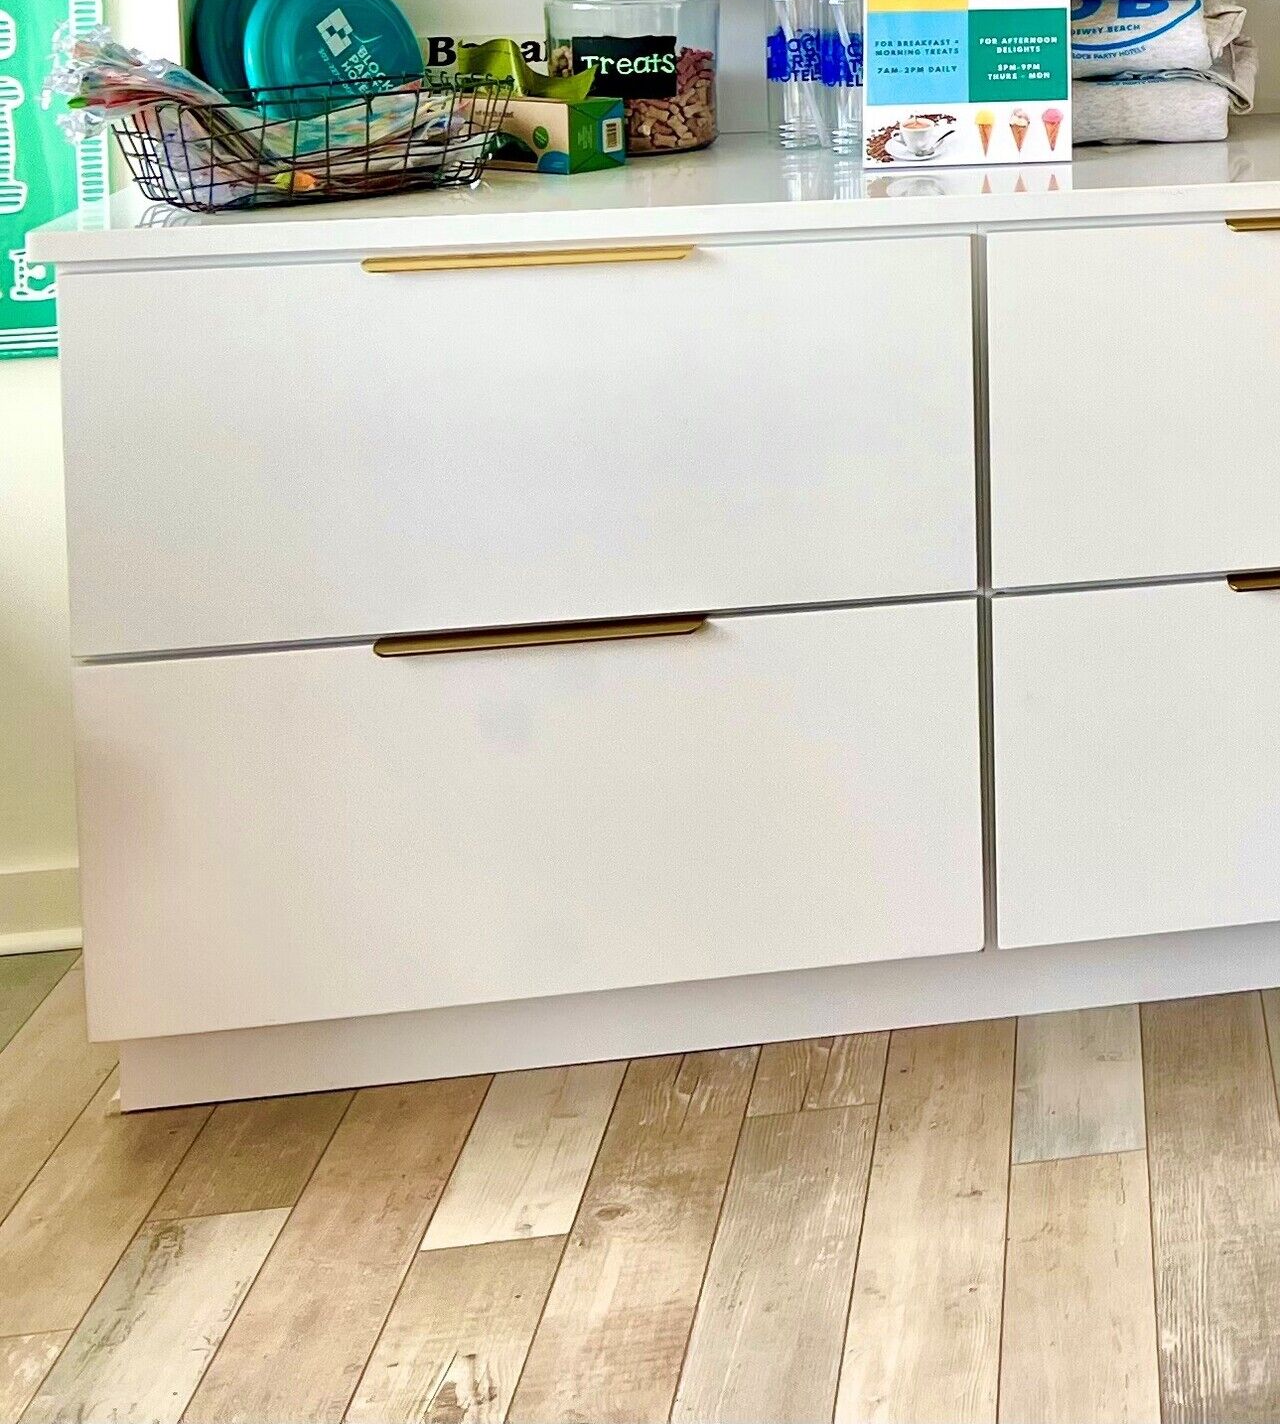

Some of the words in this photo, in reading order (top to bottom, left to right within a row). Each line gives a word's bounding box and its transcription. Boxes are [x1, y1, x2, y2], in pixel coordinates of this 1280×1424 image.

[1107, 23, 1141, 34] BEACH
[897, 39, 950, 47] BREAKFAST
[1001, 37, 1058, 45] AFTERNOON
[996, 46, 1041, 54] DELIGHTS
[580, 52, 676, 75] Treats
[928, 65, 957, 73] DAILY
